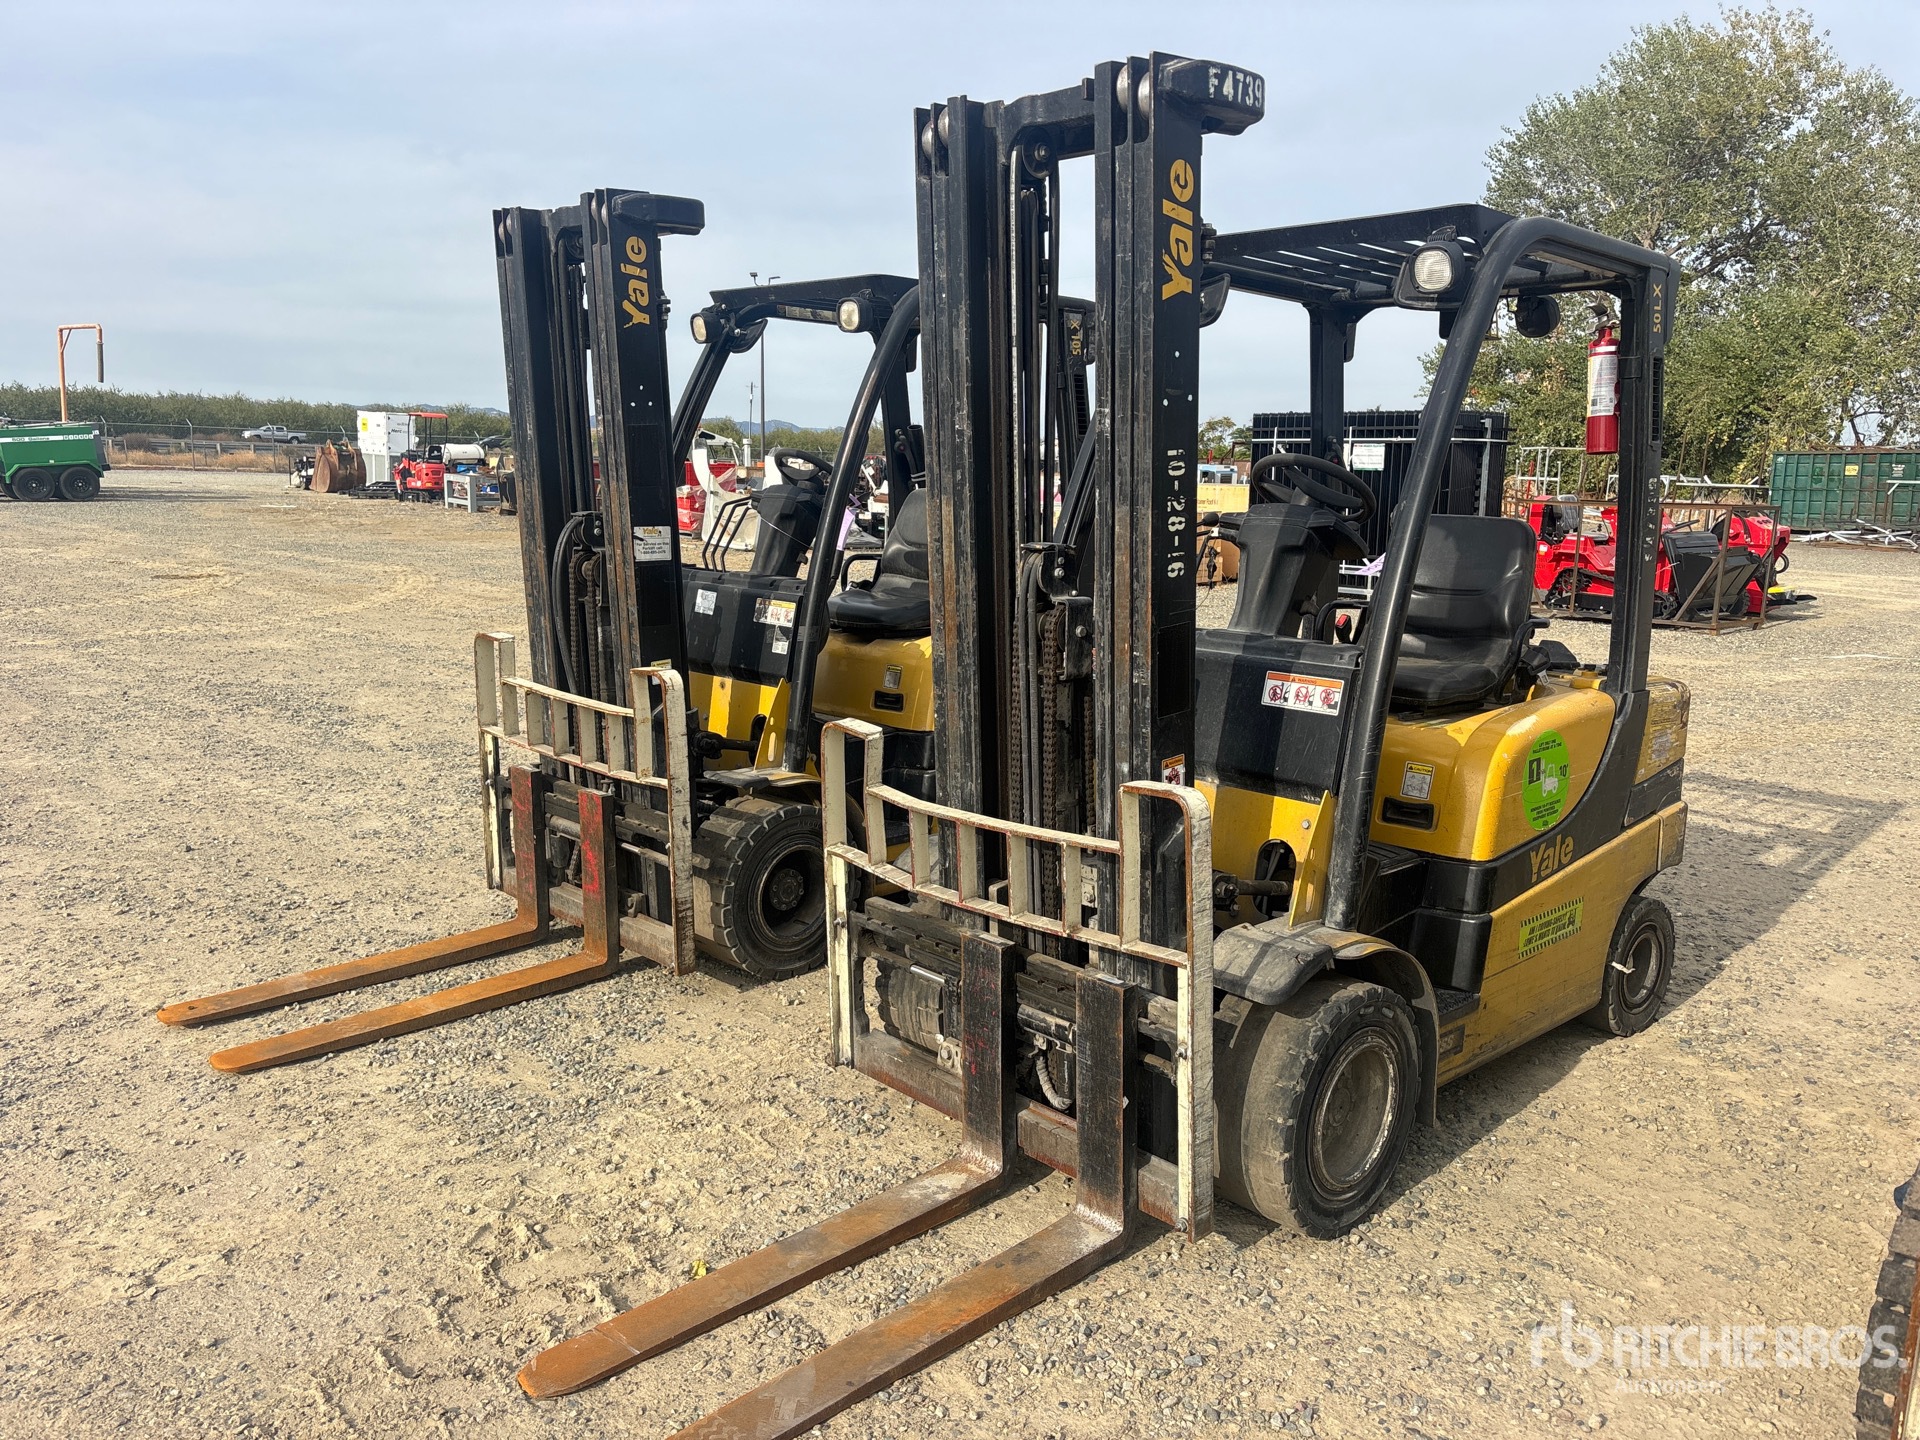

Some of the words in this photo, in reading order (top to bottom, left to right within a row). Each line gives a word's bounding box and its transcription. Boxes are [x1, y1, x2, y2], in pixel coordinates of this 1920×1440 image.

[1208, 65, 1264, 109] F4739
[1161, 159, 1195, 301] Yale
[620, 236, 650, 329] Yale
[1653, 283, 1662, 334] 50LX
[1167, 449, 1187, 578] 10-28-16
[1530, 833, 1574, 883] Yale
